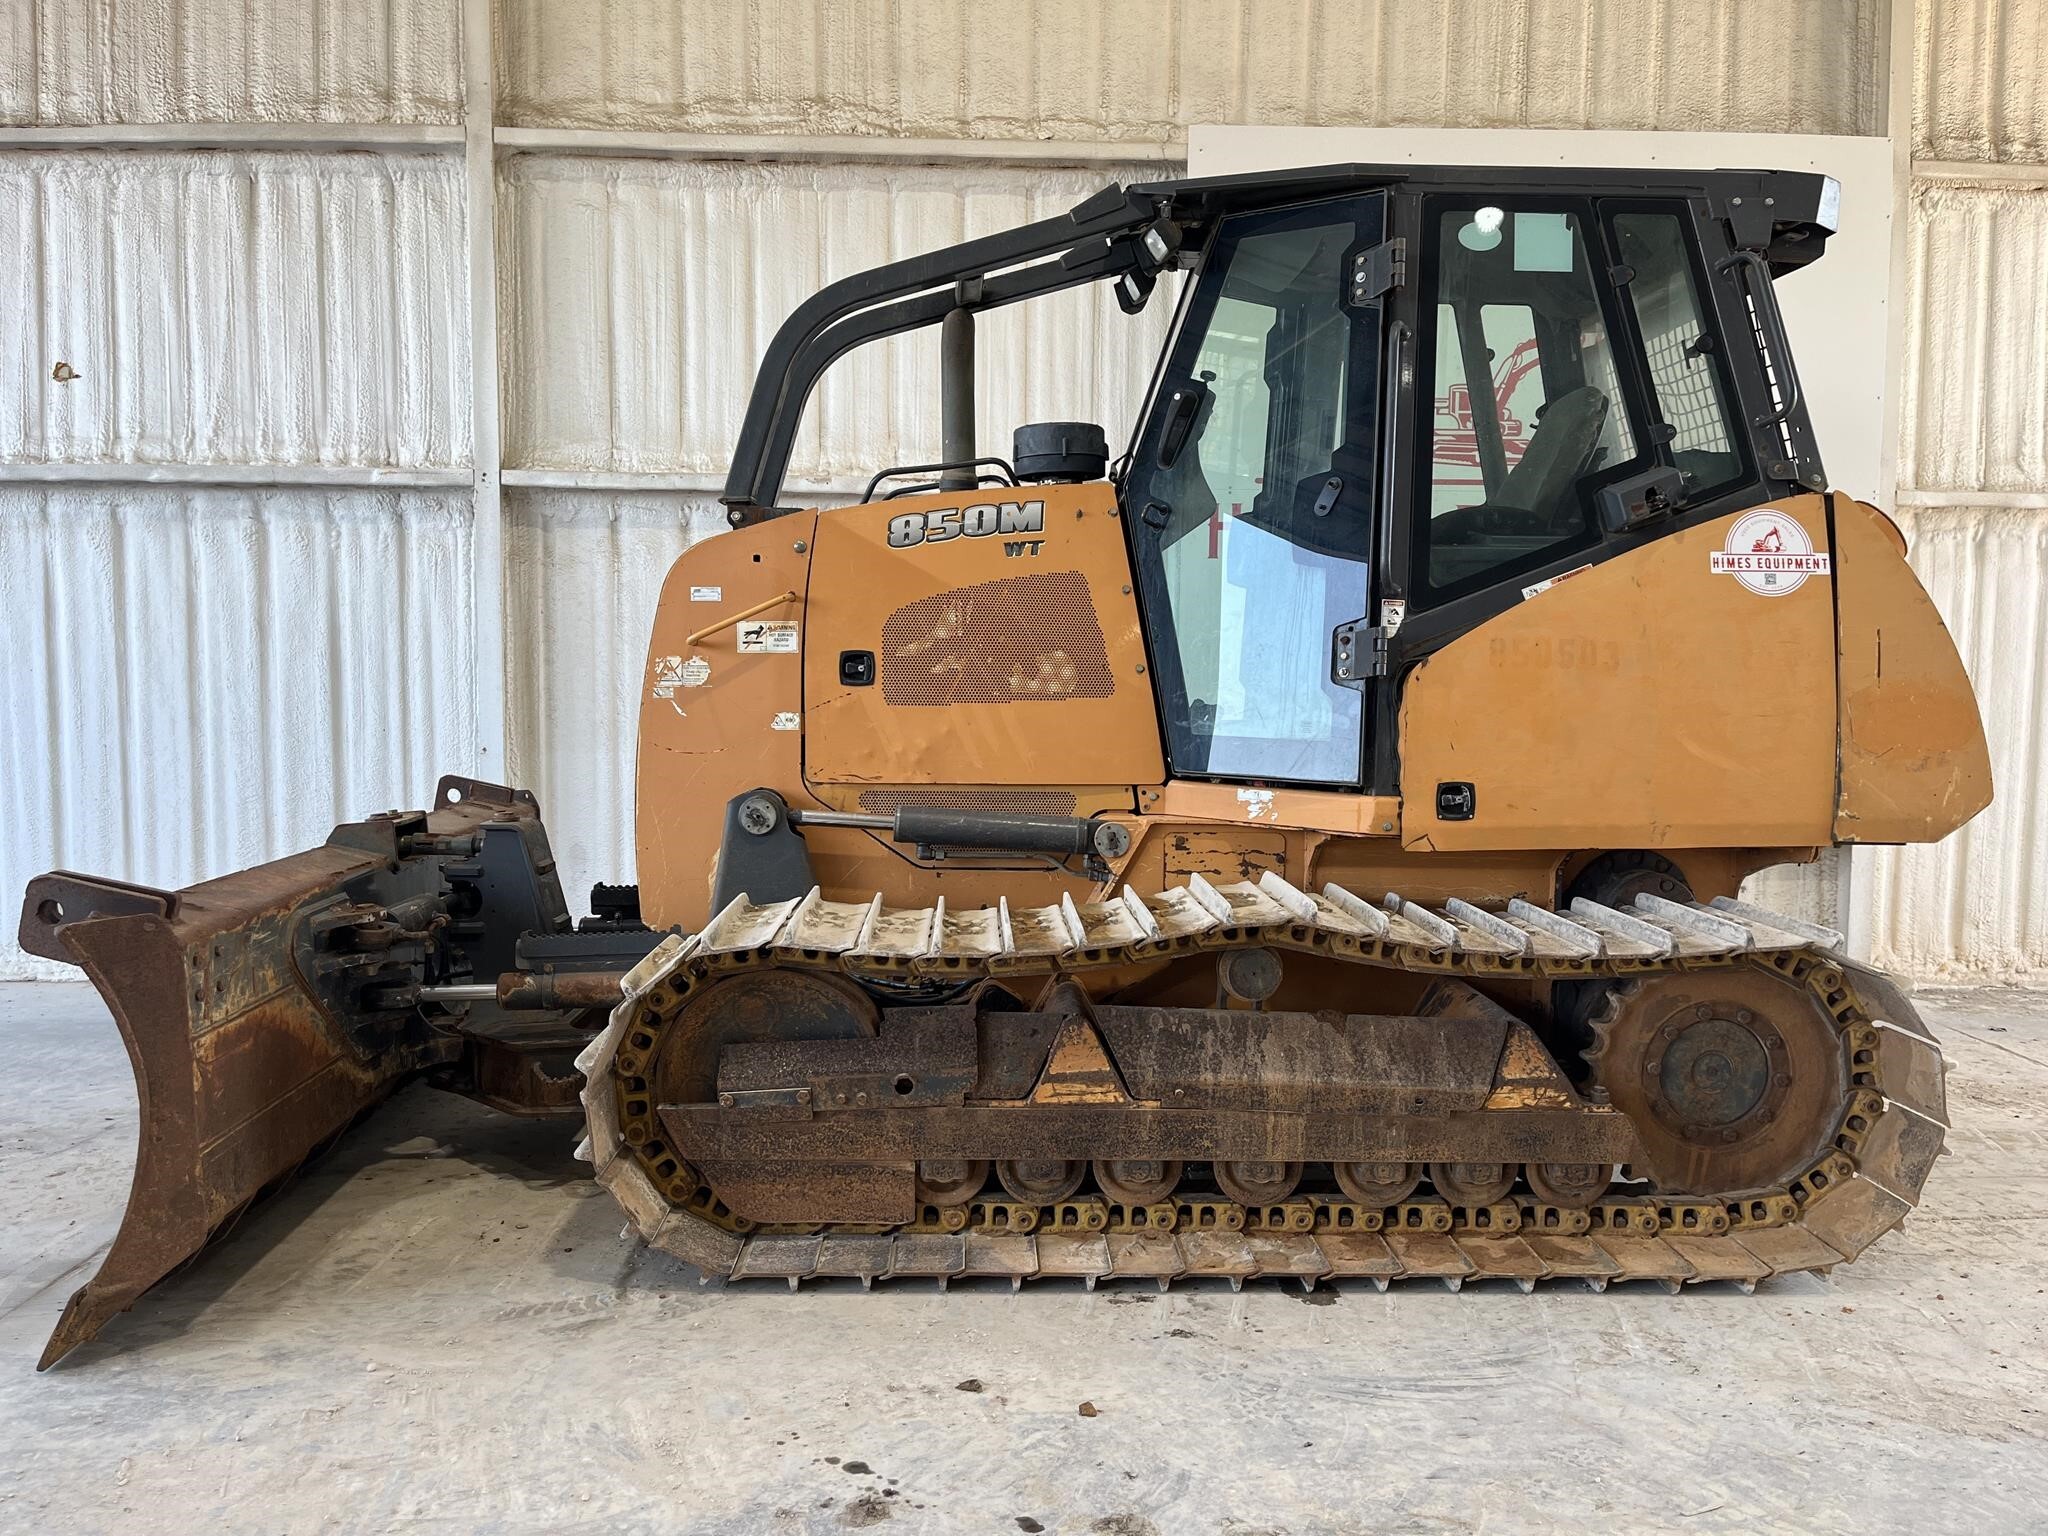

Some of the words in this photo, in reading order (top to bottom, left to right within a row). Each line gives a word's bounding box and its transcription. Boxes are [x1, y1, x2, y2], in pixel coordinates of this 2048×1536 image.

[887, 500, 1045, 549] 850M
[1003, 539, 1045, 558] WT
[1712, 557, 1752, 569] HIMES
[1757, 558, 1828, 570] EQUIPMENT
